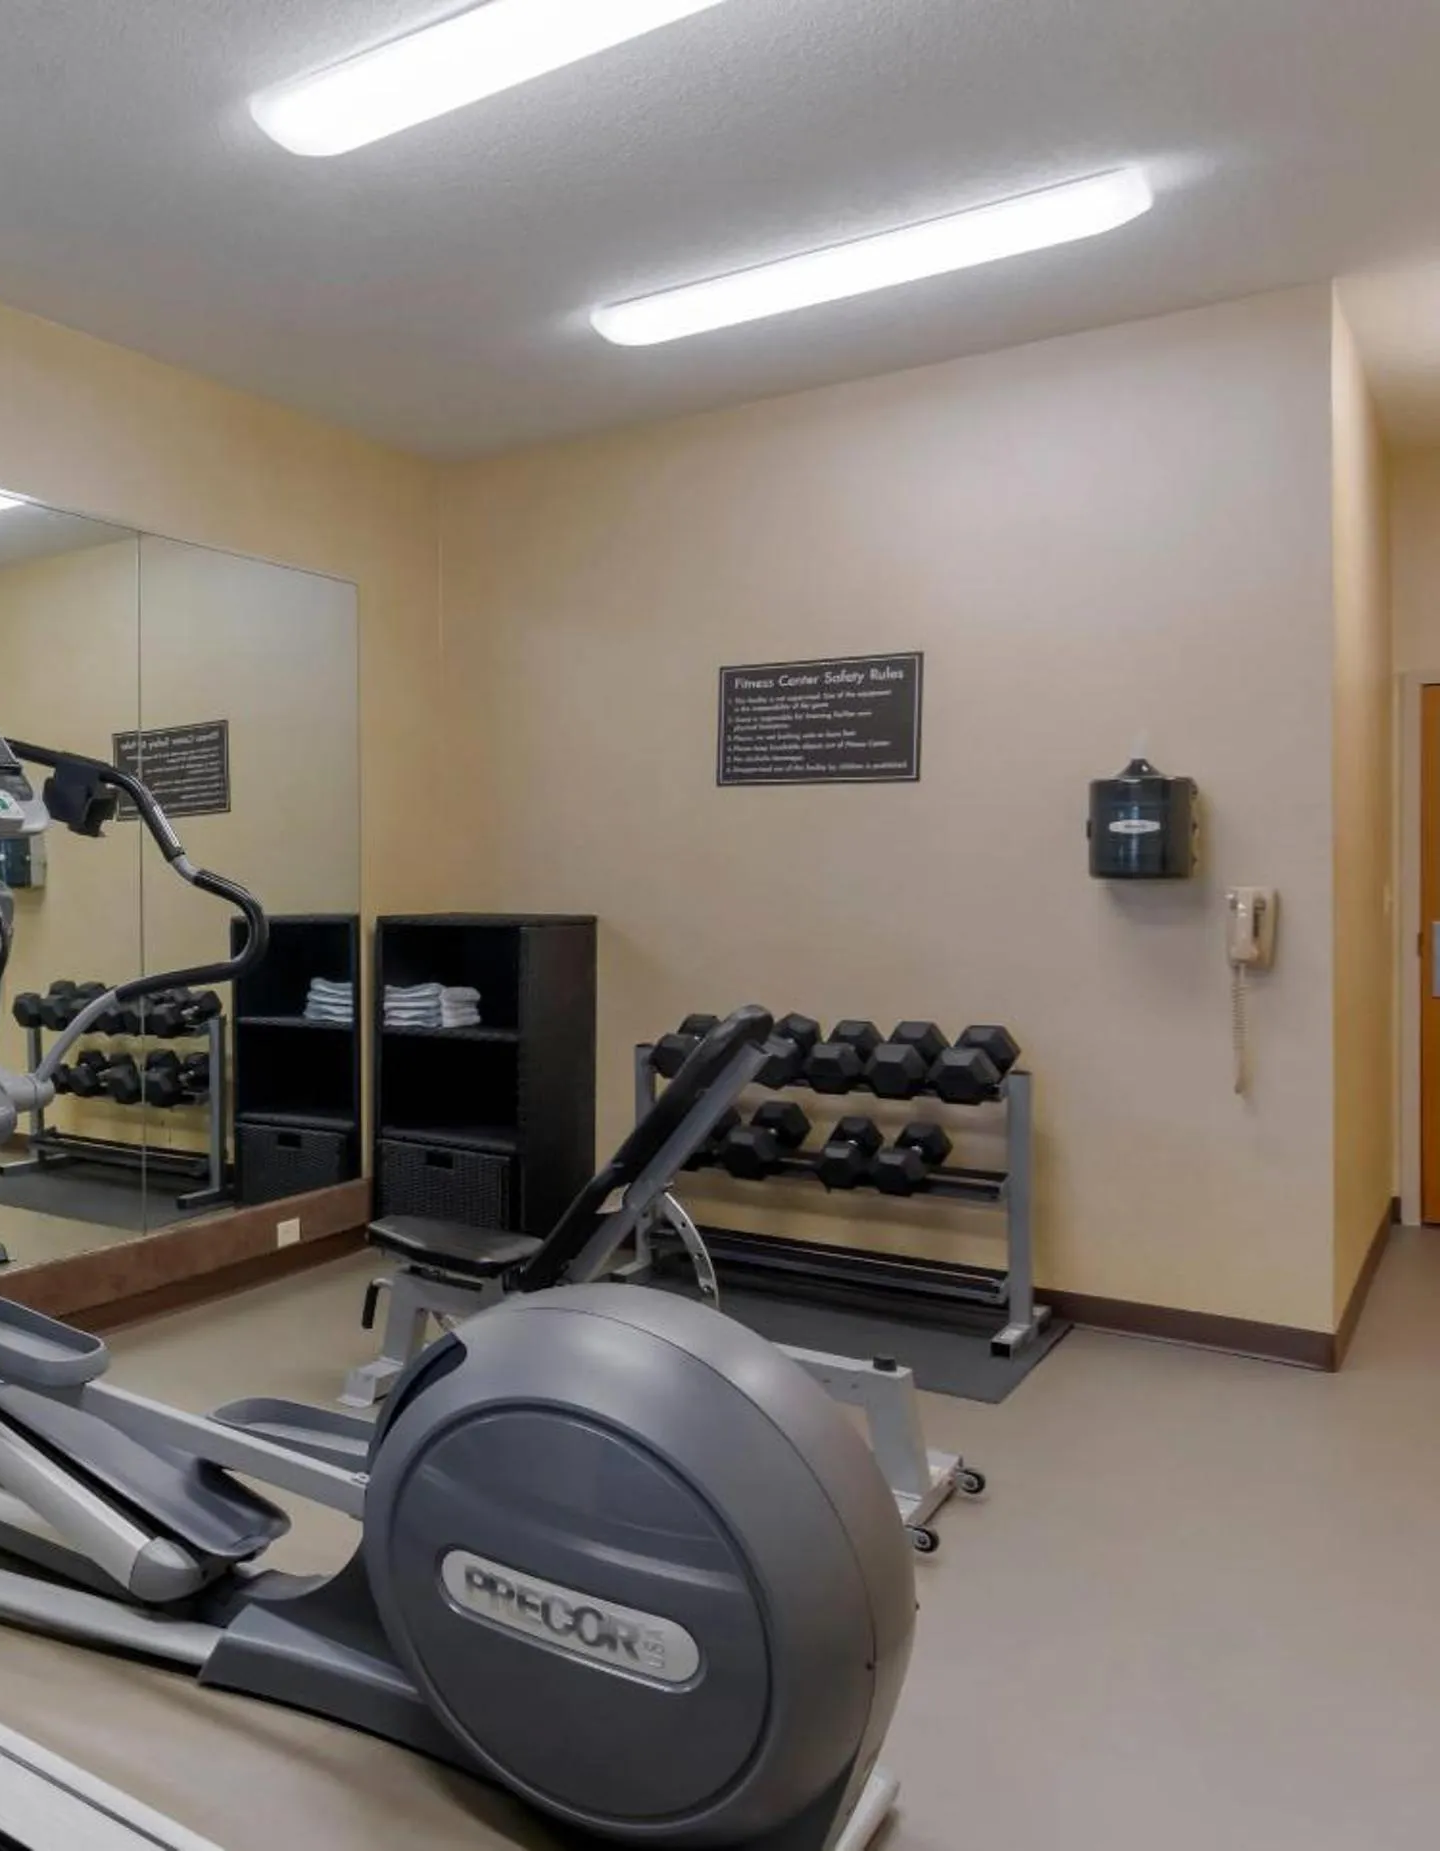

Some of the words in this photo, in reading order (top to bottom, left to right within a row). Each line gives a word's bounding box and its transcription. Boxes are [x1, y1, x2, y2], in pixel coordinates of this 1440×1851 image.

[734, 677, 775, 689] Fitness
[778, 675, 820, 687] Center
[824, 670, 865, 685] Safety
[869, 667, 904, 681] Rules
[464, 1565, 641, 1662] PRECOR
